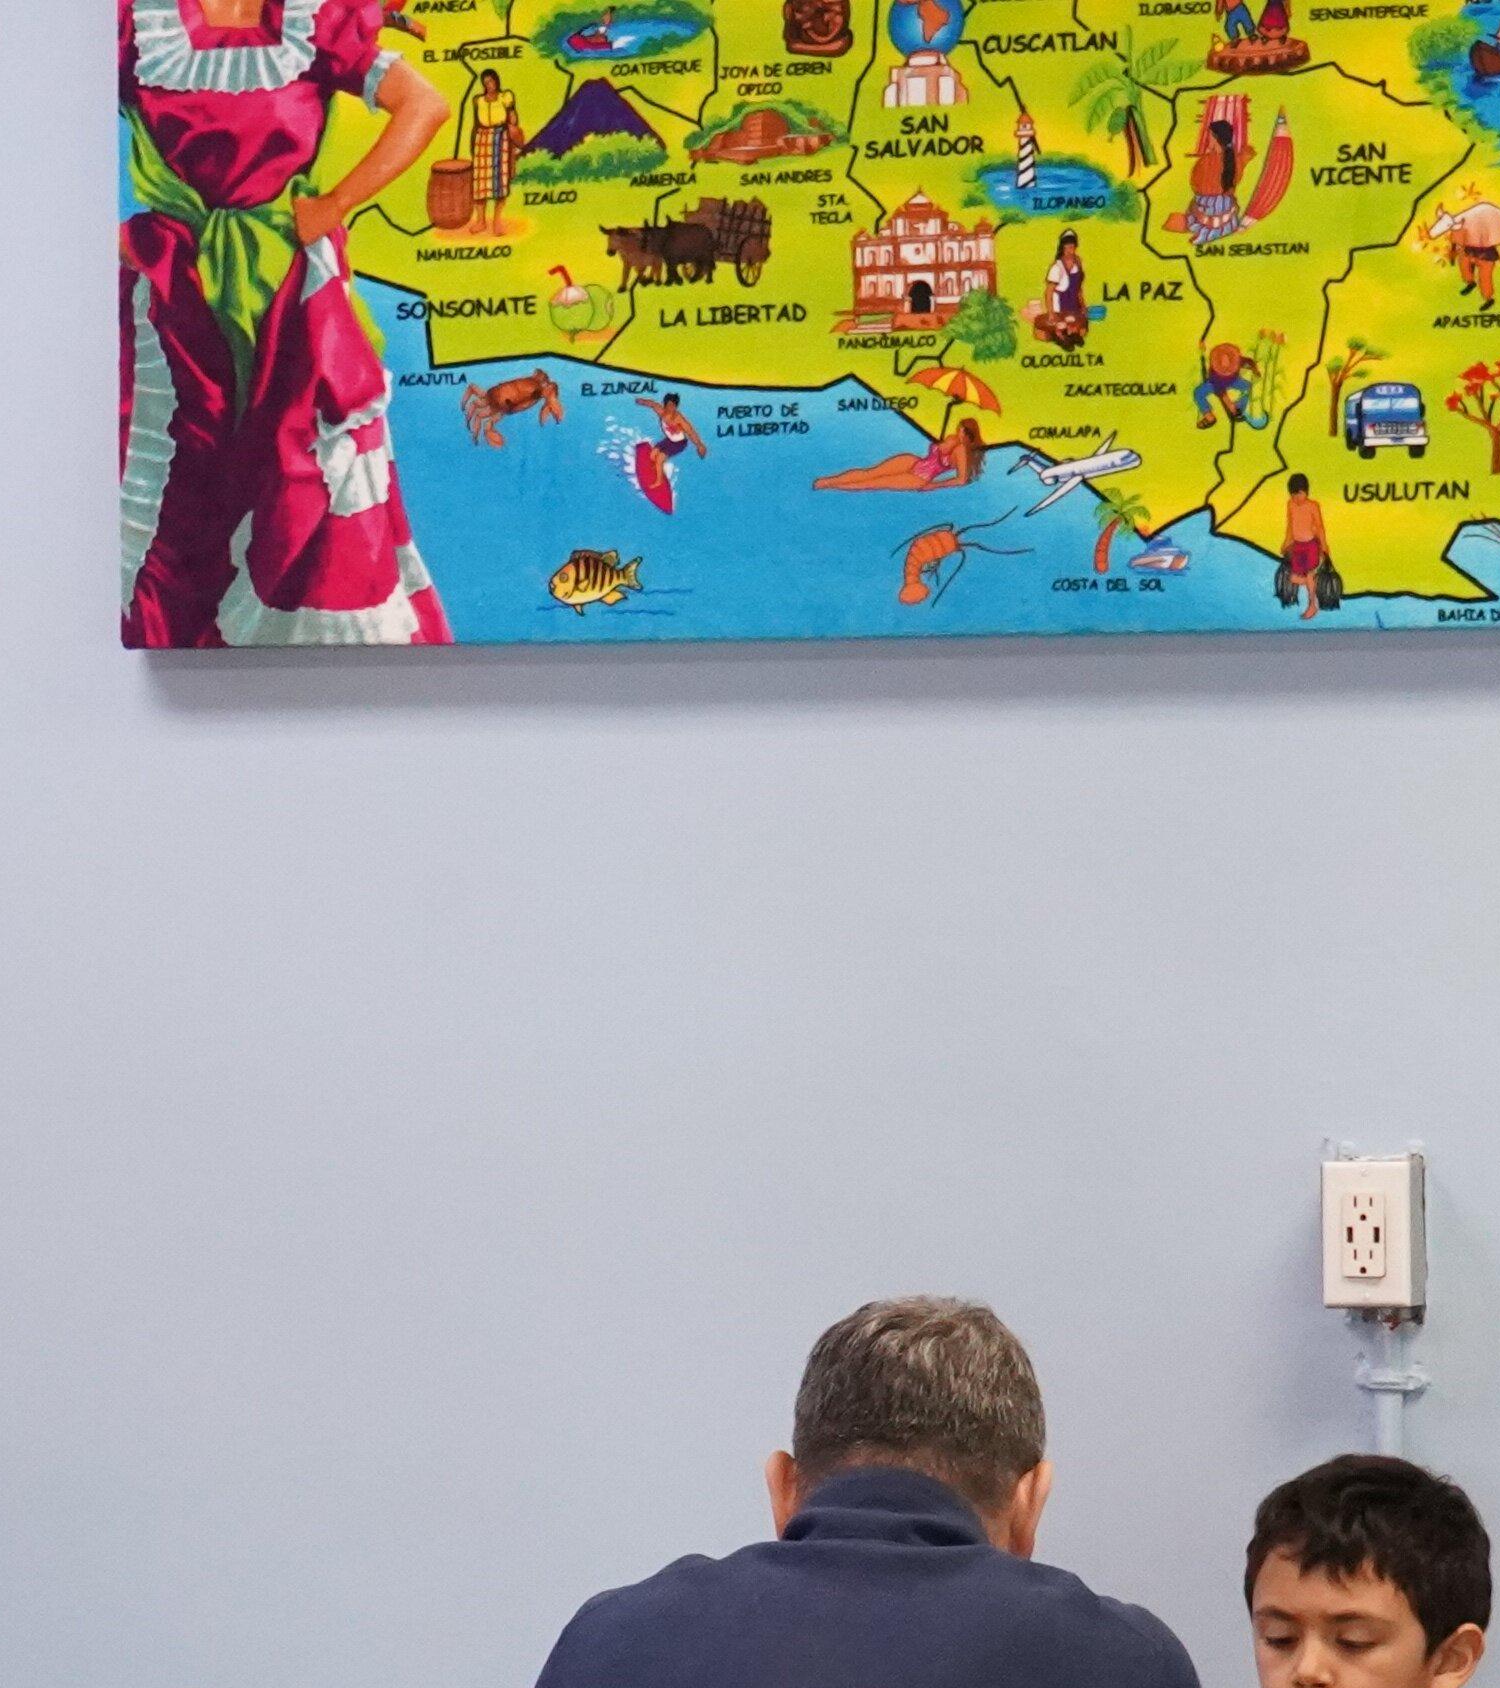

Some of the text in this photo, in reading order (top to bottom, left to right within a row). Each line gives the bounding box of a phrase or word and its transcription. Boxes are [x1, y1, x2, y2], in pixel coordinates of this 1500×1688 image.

[1138, 1, 1212, 17] ILOBASCO
[1308, 4, 1429, 22] SENSUNTEPEQUE
[982, 30, 1118, 55] CUSCATLAN
[423, 45, 523, 63] EL IMPOSIBLE
[610, 58, 703, 78] COATEPEQUE
[719, 61, 833, 81] JOYA DE CEREN
[737, 81, 783, 97] OPICO
[900, 113, 949, 135] SAN
[864, 135, 984, 160] SALVADOR
[1336, 141, 1387, 164] SAN
[630, 171, 697, 188] ARMENIA
[739, 168, 834, 186] SAN ANDRES
[1310, 163, 1413, 187] VICENTE
[523, 189, 578, 207] IZALCO
[1032, 194, 1106, 211] ILOPANGO
[809, 210, 854, 225] TECLA
[415, 245, 513, 262] NAHUIZALCO
[1195, 241, 1310, 258] SAN SEBASTIAN
[1102, 281, 1184, 302] LA PAZ
[395, 295, 538, 321] SONSONATE
[659, 303, 807, 328] LA LIBERTAD
[1021, 353, 1105, 369] OLOCUILTA
[398, 372, 468, 388] ACAJUTLA
[581, 379, 659, 397] EL ZUNZAL
[1063, 382, 1177, 398] ZACATECOLUCA
[717, 402, 800, 419] PUERTO DE
[837, 396, 919, 412] SAN DIEGO
[716, 420, 810, 438] LA LIBERTAD
[1029, 424, 1101, 441] COMALAPA
[1343, 480, 1470, 503] USULUTAN
[1051, 576, 1166, 594] COSTA DEL SOL
[1437, 607, 1489, 623] BAHIA
